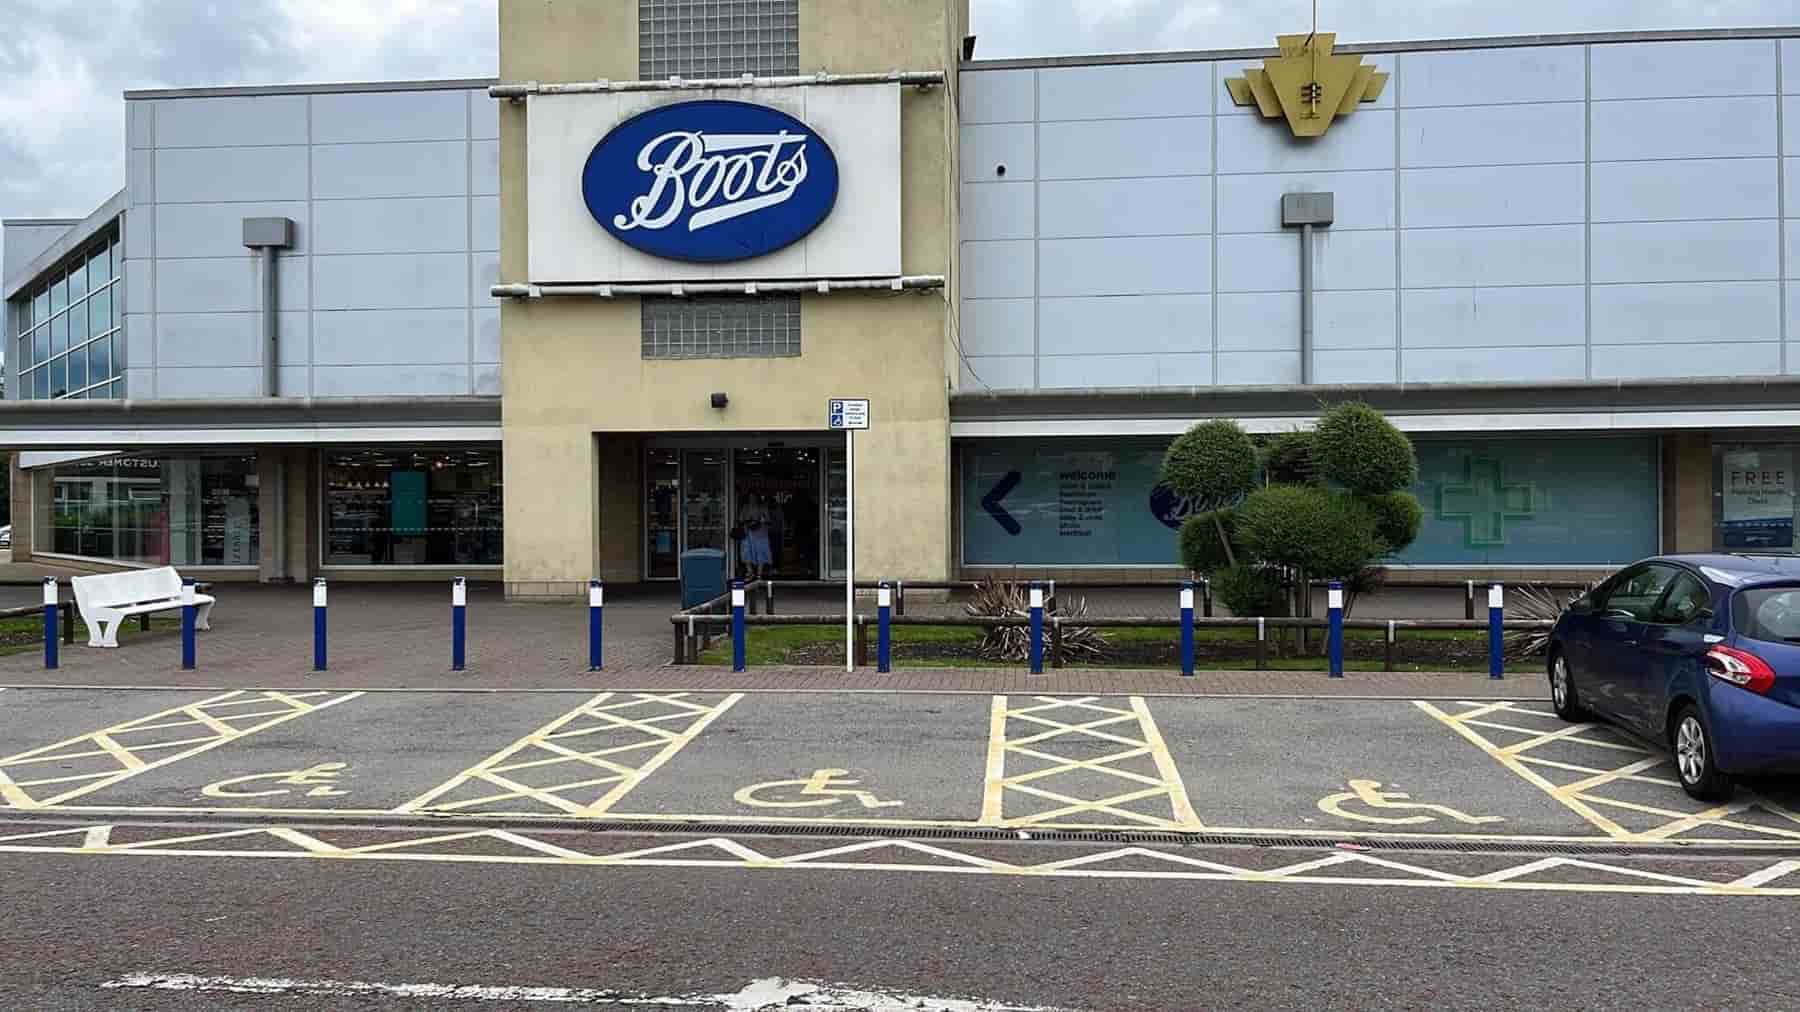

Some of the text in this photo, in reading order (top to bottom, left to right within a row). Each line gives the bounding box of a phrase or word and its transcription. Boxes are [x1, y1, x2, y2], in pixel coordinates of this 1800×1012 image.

[613, 129, 808, 232] Boots
[1059, 469, 1117, 480] welcome
[1731, 471, 1785, 486] FREE
